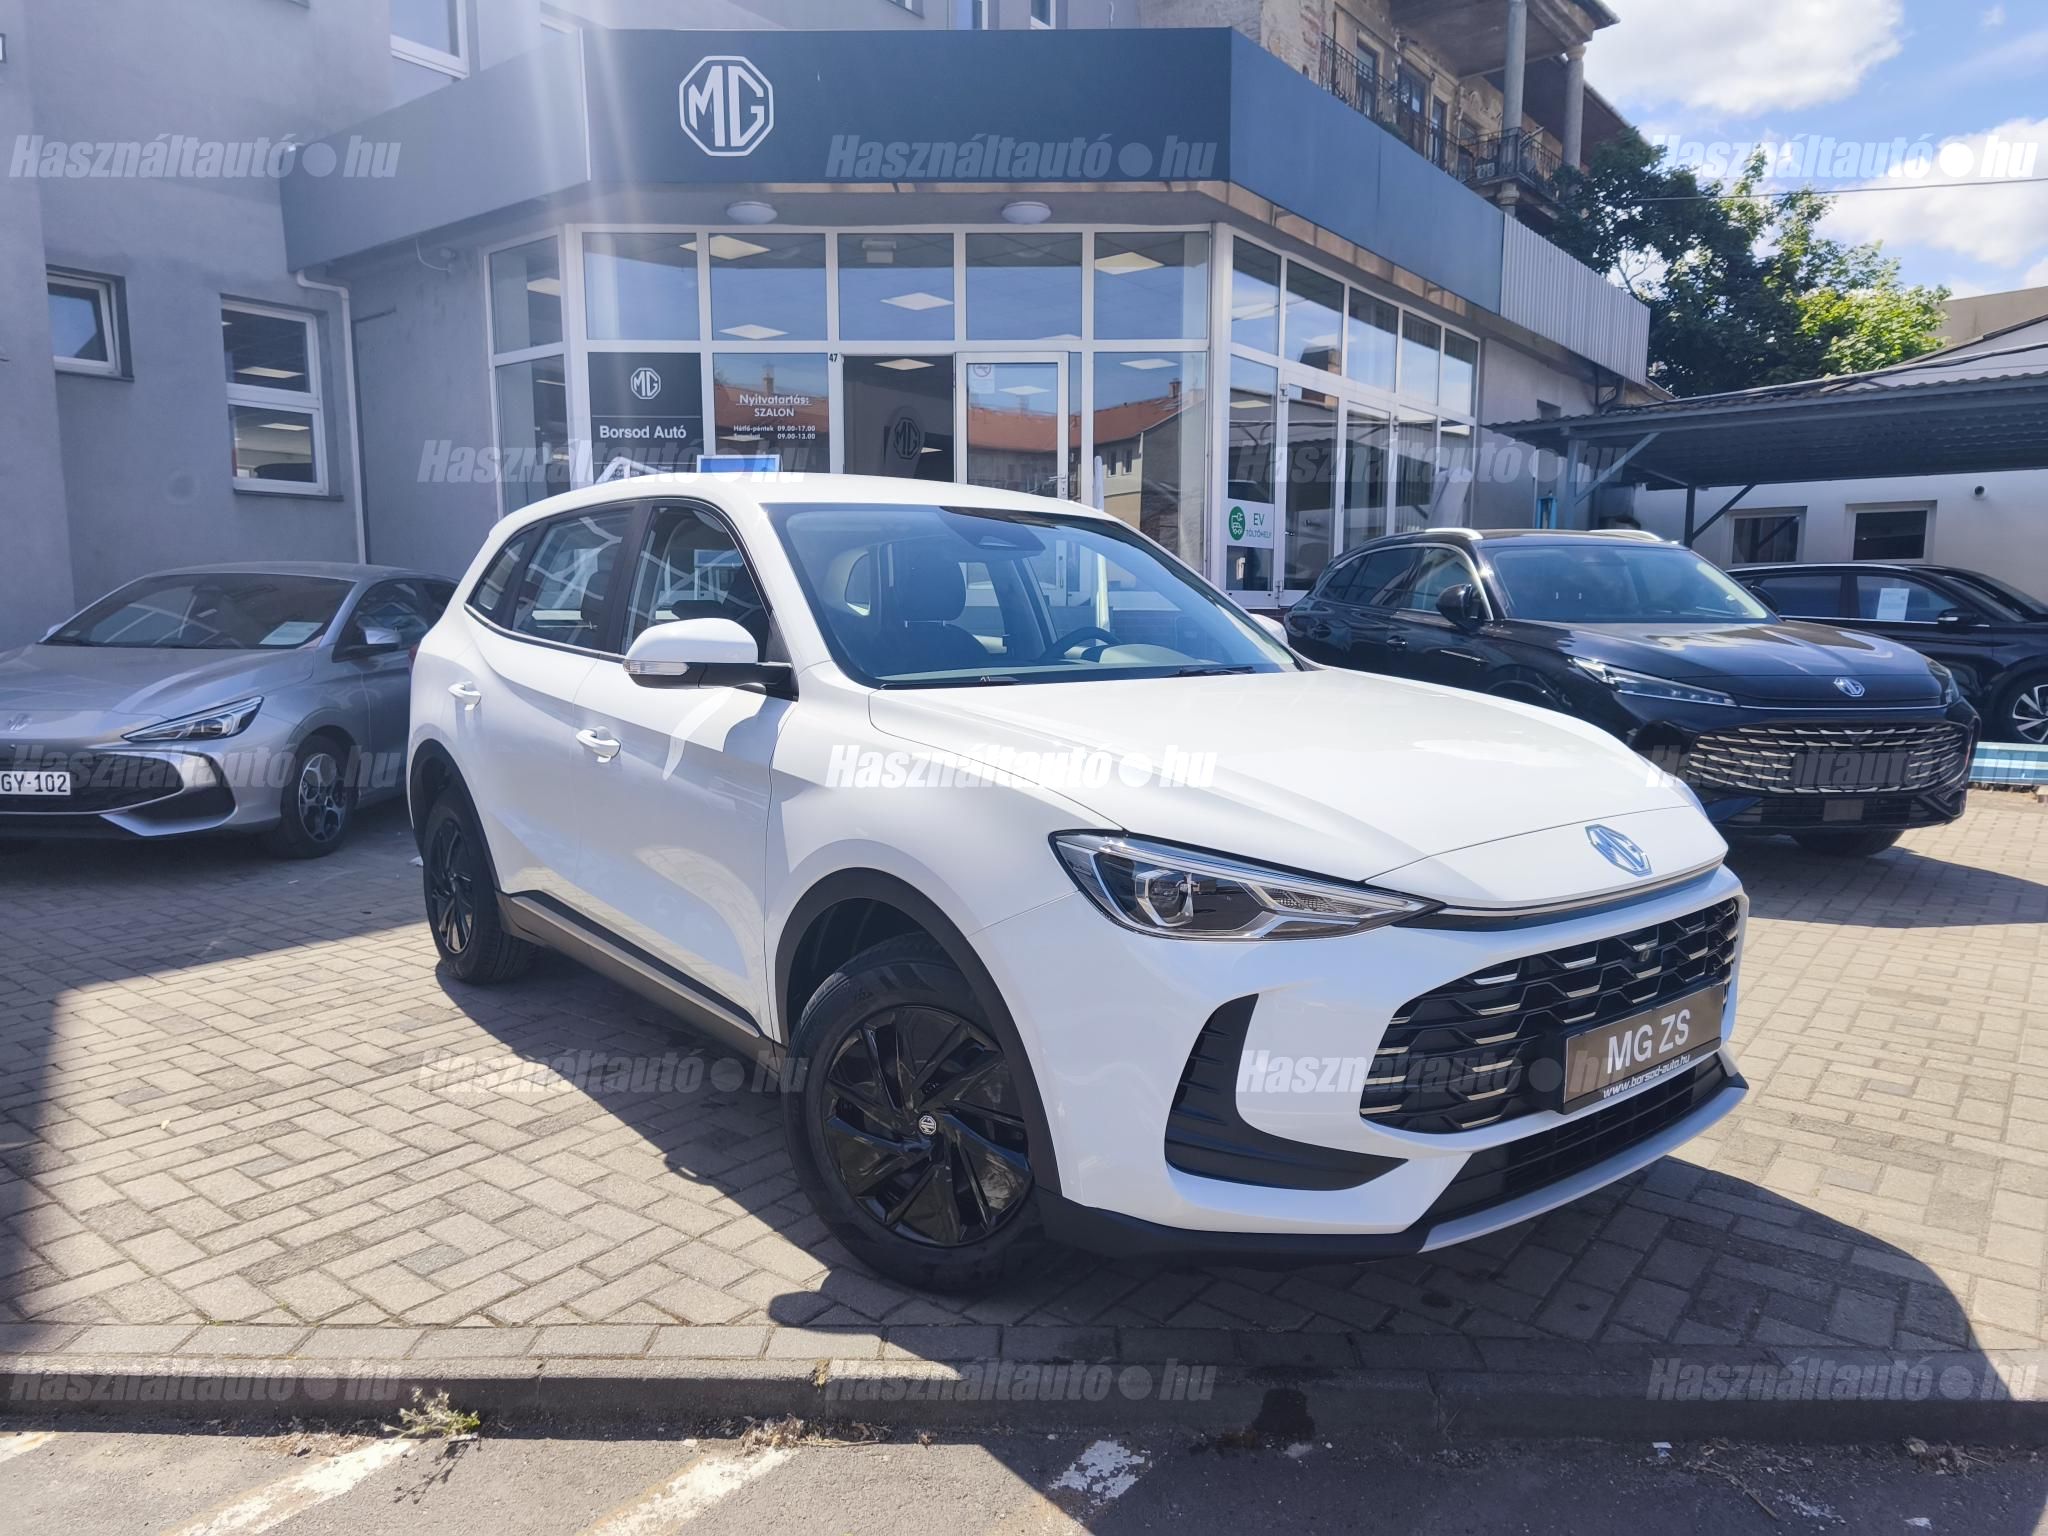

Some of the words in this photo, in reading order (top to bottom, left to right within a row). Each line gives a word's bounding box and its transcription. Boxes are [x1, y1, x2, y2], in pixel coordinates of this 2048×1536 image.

[685, 62, 768, 150] MG
[829, 353, 838, 362] 47
[632, 370, 659, 398] MG
[754, 408, 795, 417] SZALON
[599, 425, 650, 439] Borsod
[653, 424, 687, 439] Autó
[895, 420, 919, 458] MG
[1253, 513, 1265, 526] EV
[1, 773, 67, 792] GY-102
[1607, 1024, 1653, 1074] MG
[1658, 1008, 1691, 1054] ZS
[1603, 1054, 1691, 1099] www.borsod-auto.hu
